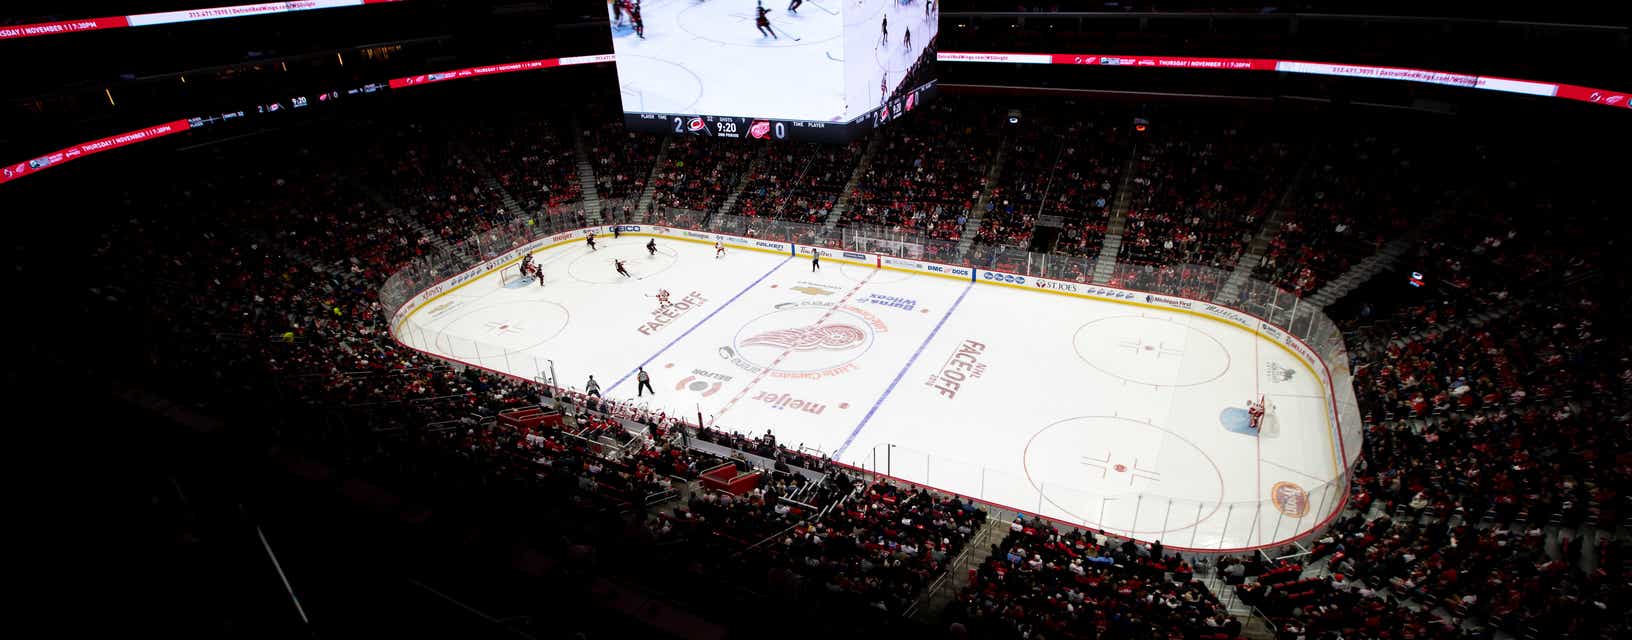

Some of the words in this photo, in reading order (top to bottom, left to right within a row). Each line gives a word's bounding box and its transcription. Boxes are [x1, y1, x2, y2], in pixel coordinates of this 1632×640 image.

[26, 25, 63, 35] NOVEMBER
[1159, 59, 1187, 67] THURSDAY
[1191, 60, 1221, 68] NOVEMBER
[292, 96, 307, 105] 9:20
[674, 117, 683, 133] 2
[717, 122, 737, 133] 9:20
[775, 122, 785, 139] 0
[82, 140, 113, 152] THURSDAY
[116, 131, 146, 145] NOVEMBER
[755, 241, 784, 250] FALKEN
[928, 265, 943, 273] DMC
[752, 391, 827, 415] meijer
